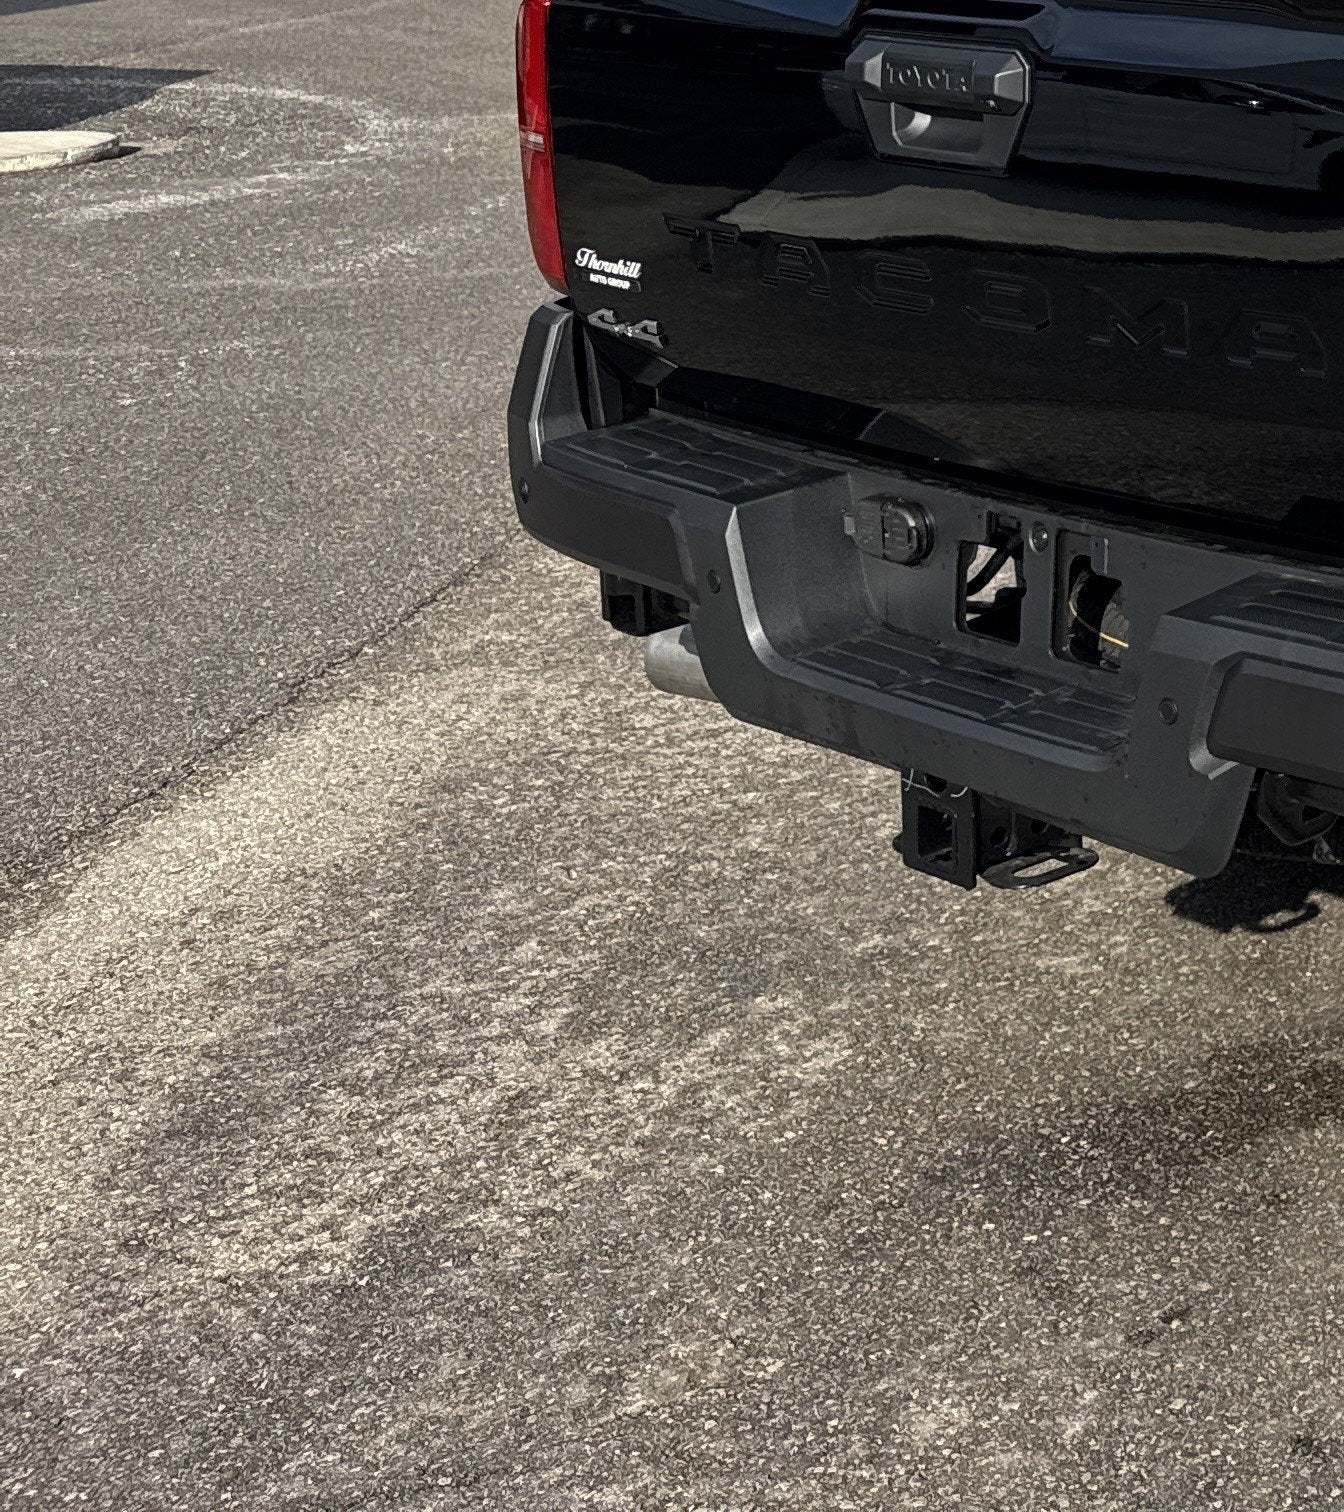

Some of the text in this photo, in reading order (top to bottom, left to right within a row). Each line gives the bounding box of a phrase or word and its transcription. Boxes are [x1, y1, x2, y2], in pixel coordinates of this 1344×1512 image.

[886, 62, 971, 93] TOYOTA
[574, 247, 642, 279] Thornhill
[662, 213, 1328, 379] TACOMA
